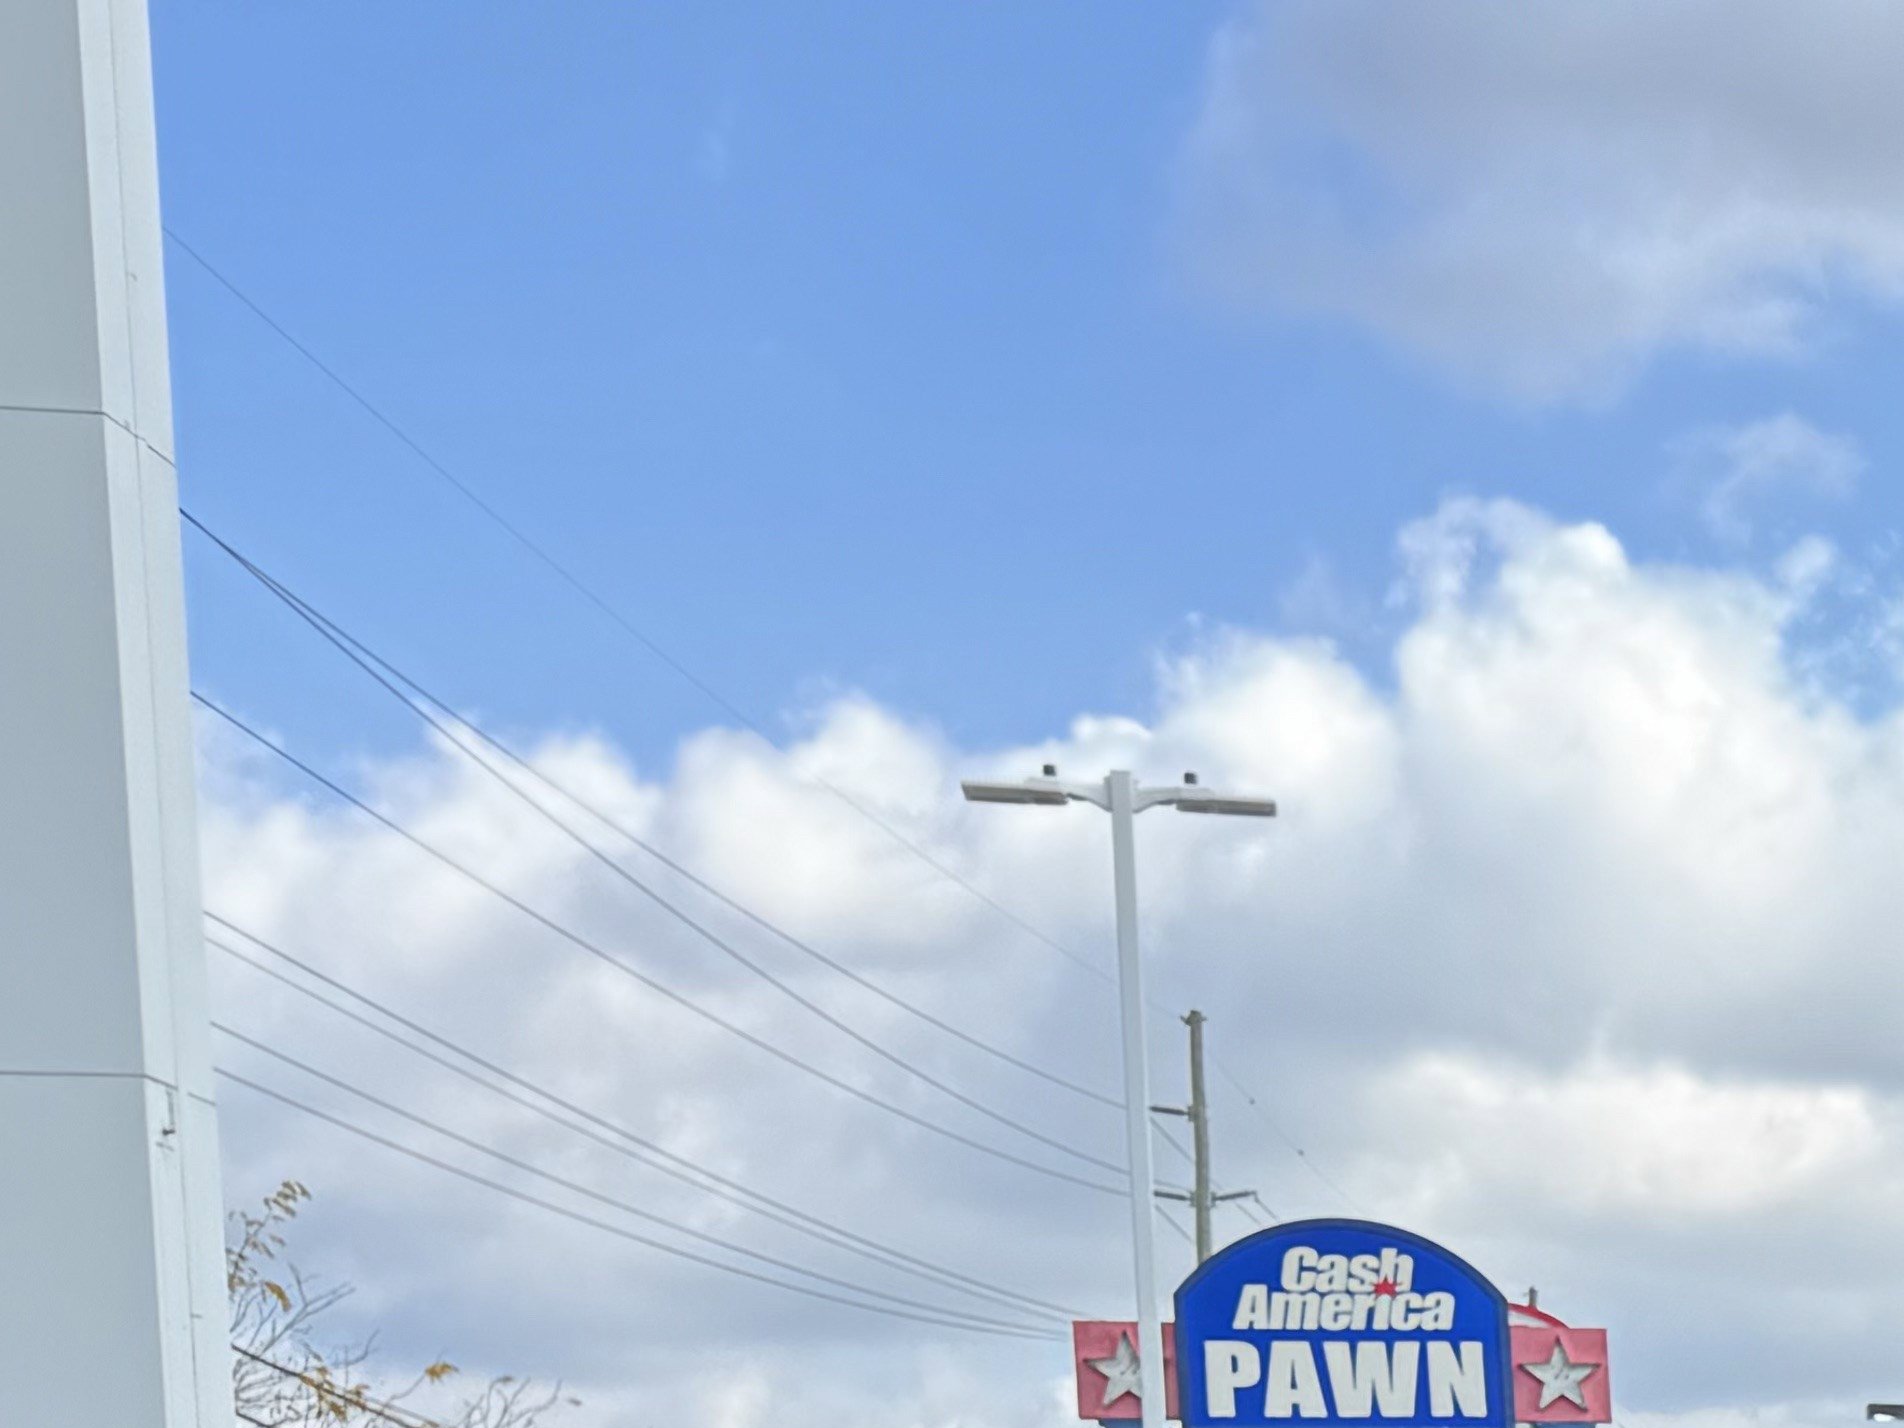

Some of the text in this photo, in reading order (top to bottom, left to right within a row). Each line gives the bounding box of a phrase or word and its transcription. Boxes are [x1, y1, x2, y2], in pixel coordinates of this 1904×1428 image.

[1281, 1246, 1414, 1293] Cash
[1232, 1283, 1456, 1332] America
[1203, 1340, 1488, 1419] PAWN
